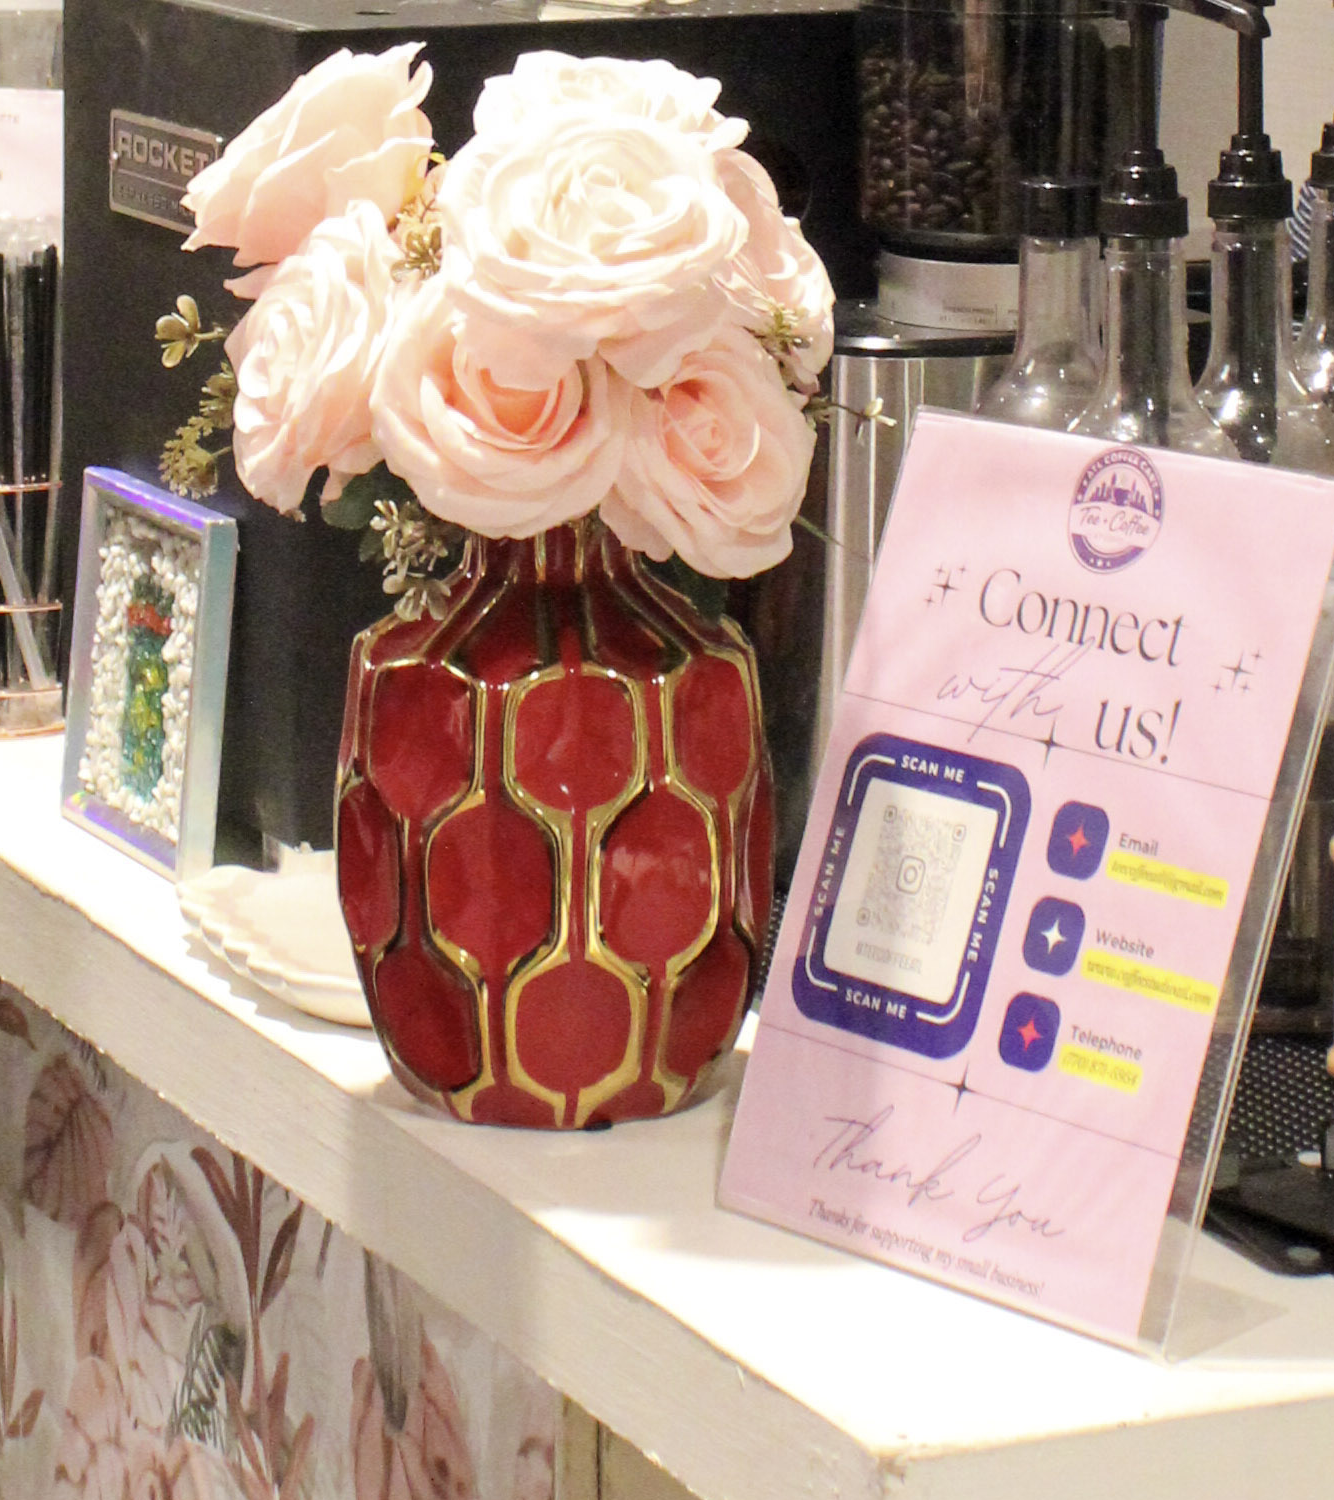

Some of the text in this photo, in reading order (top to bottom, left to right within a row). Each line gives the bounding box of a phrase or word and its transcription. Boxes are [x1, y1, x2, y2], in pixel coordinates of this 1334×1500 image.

[118, 130, 209, 177] ROCKET
[1108, 510, 1150, 536] Coffee
[979, 568, 1186, 667] Connect
[936, 636, 1183, 765] with us!
[901, 755, 966, 784] SCAN ME
[1118, 832, 1159, 857] Email
[813, 826, 847, 918] SCAN ME
[966, 867, 999, 963] SCAN ME
[1096, 927, 1155, 959] Website
[845, 988, 907, 1020] SCAN ME
[1071, 1024, 1143, 1061] Telephone
[812, 1103, 1066, 1244] Thank You
[808, 1199, 1047, 1297] Thanks for supporting my small business!
